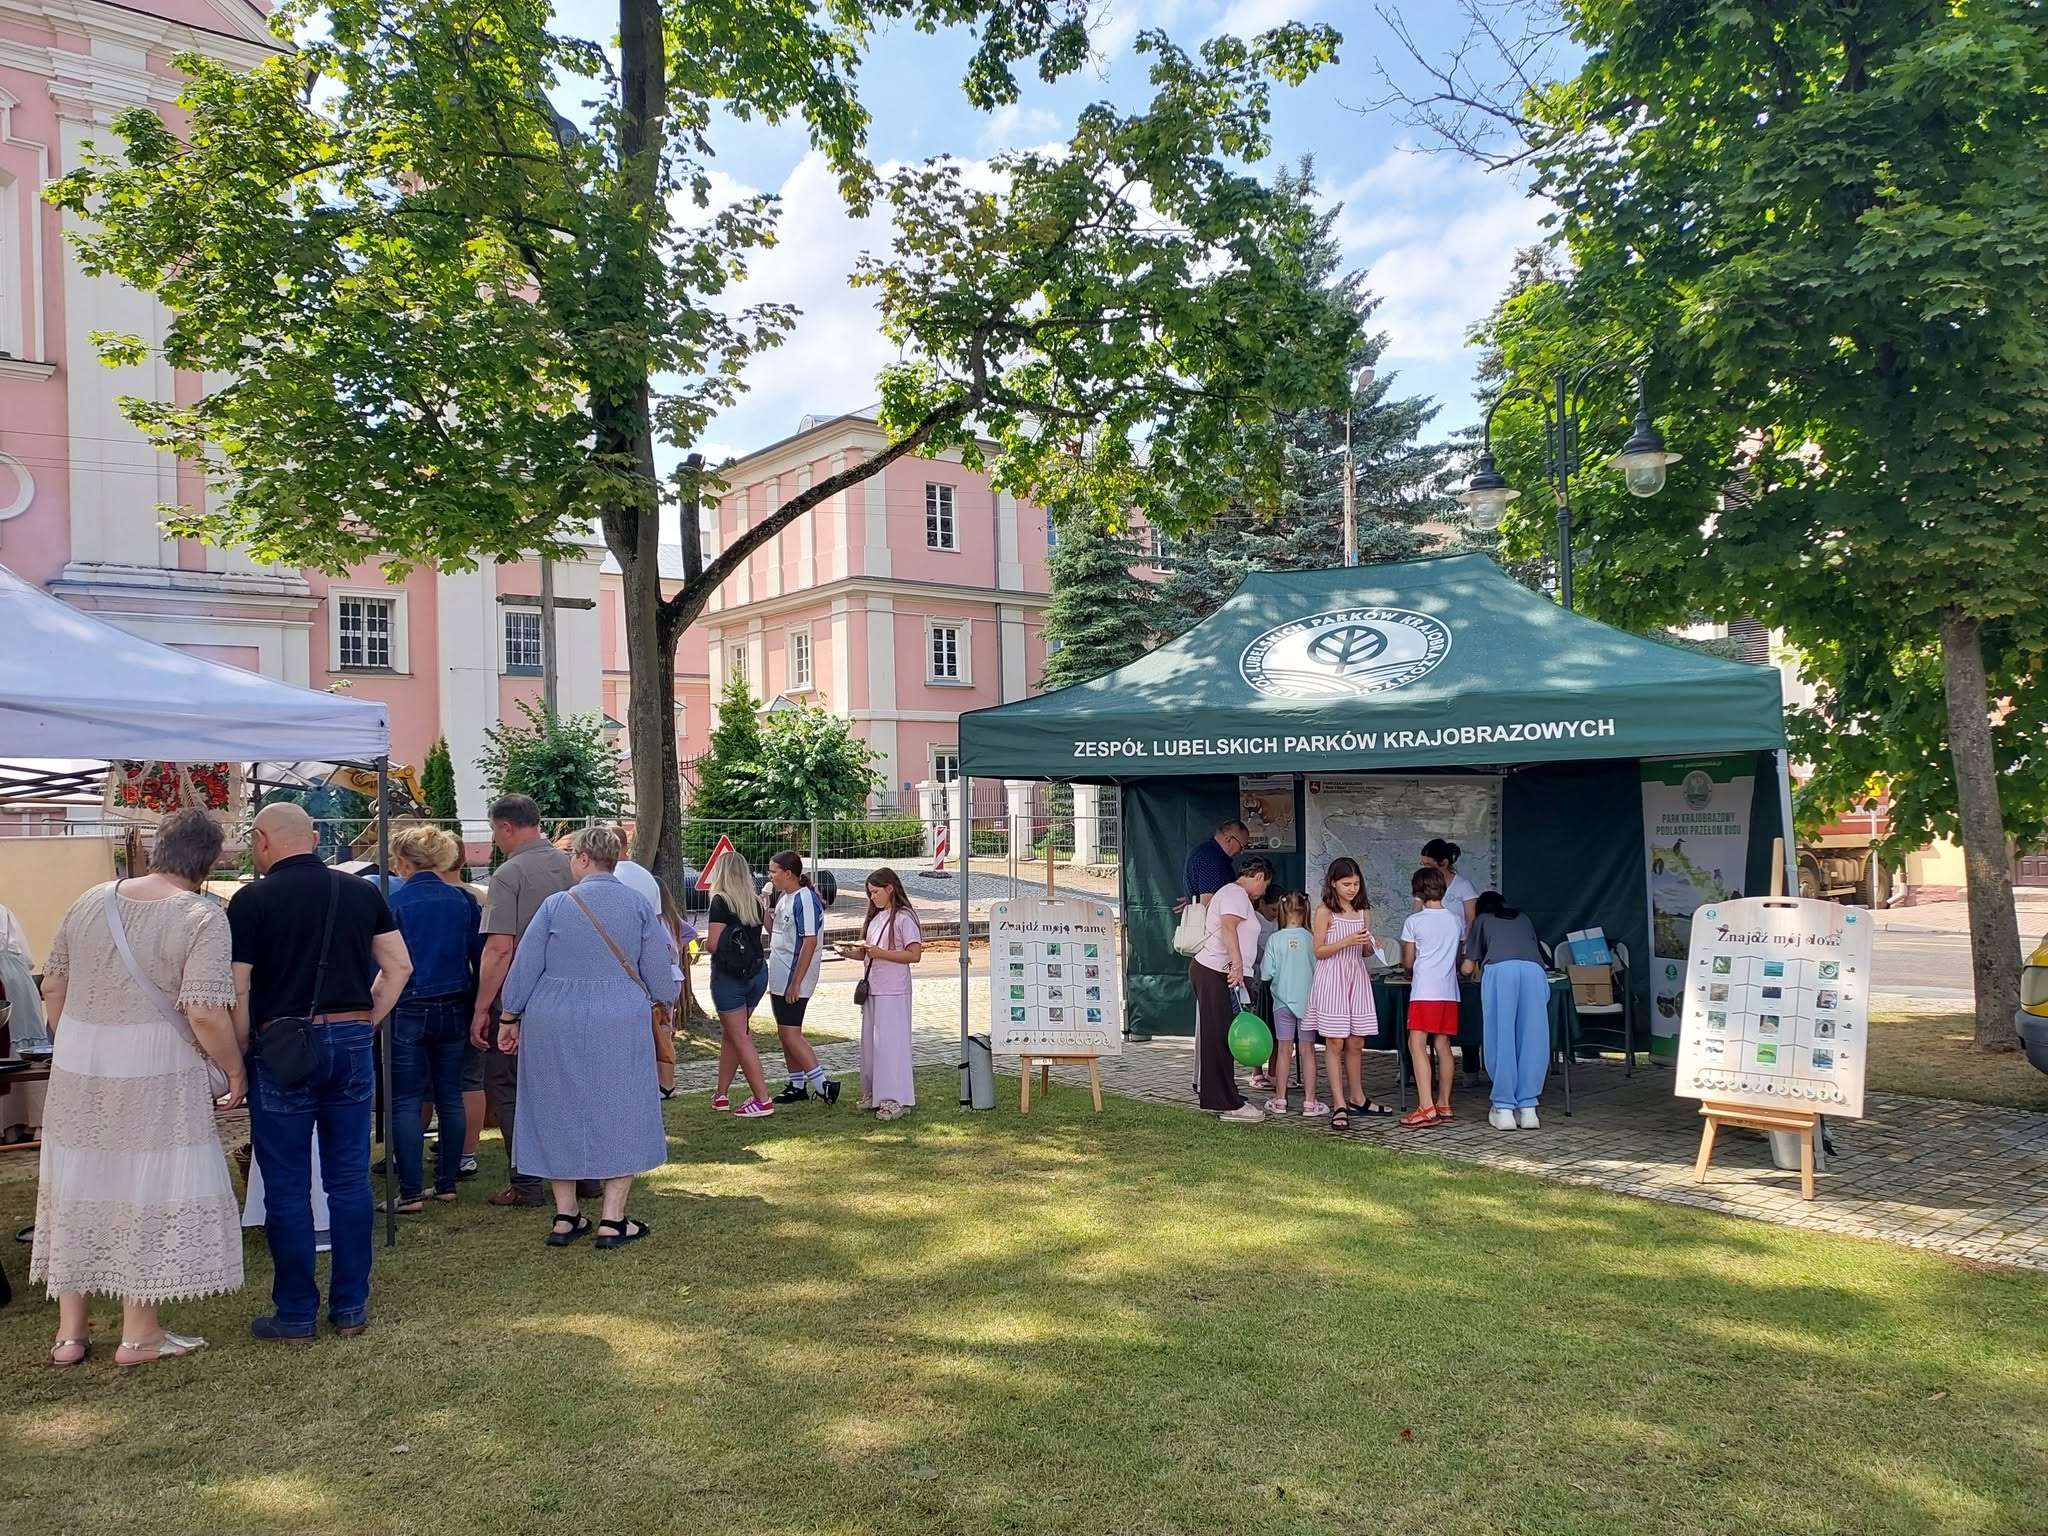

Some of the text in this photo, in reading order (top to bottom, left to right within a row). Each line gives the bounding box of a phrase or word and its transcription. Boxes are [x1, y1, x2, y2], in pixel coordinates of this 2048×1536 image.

[1245, 623, 1306, 673] LUBELSKICH
[1311, 608, 1400, 627] PARKÓW
[1073, 718, 1615, 758] ZESPÓŁ LUBELSKICH PARKÓW KRAJOBRAZOWYCH
[1662, 811, 1735, 823] PARK KRAJOBRAZOWY
[1656, 825, 1689, 836] PODLASKI
[999, 920, 1039, 934] Znajdź
[1717, 929, 1769, 945] Znajdź
[1773, 932, 1802, 948] mój
